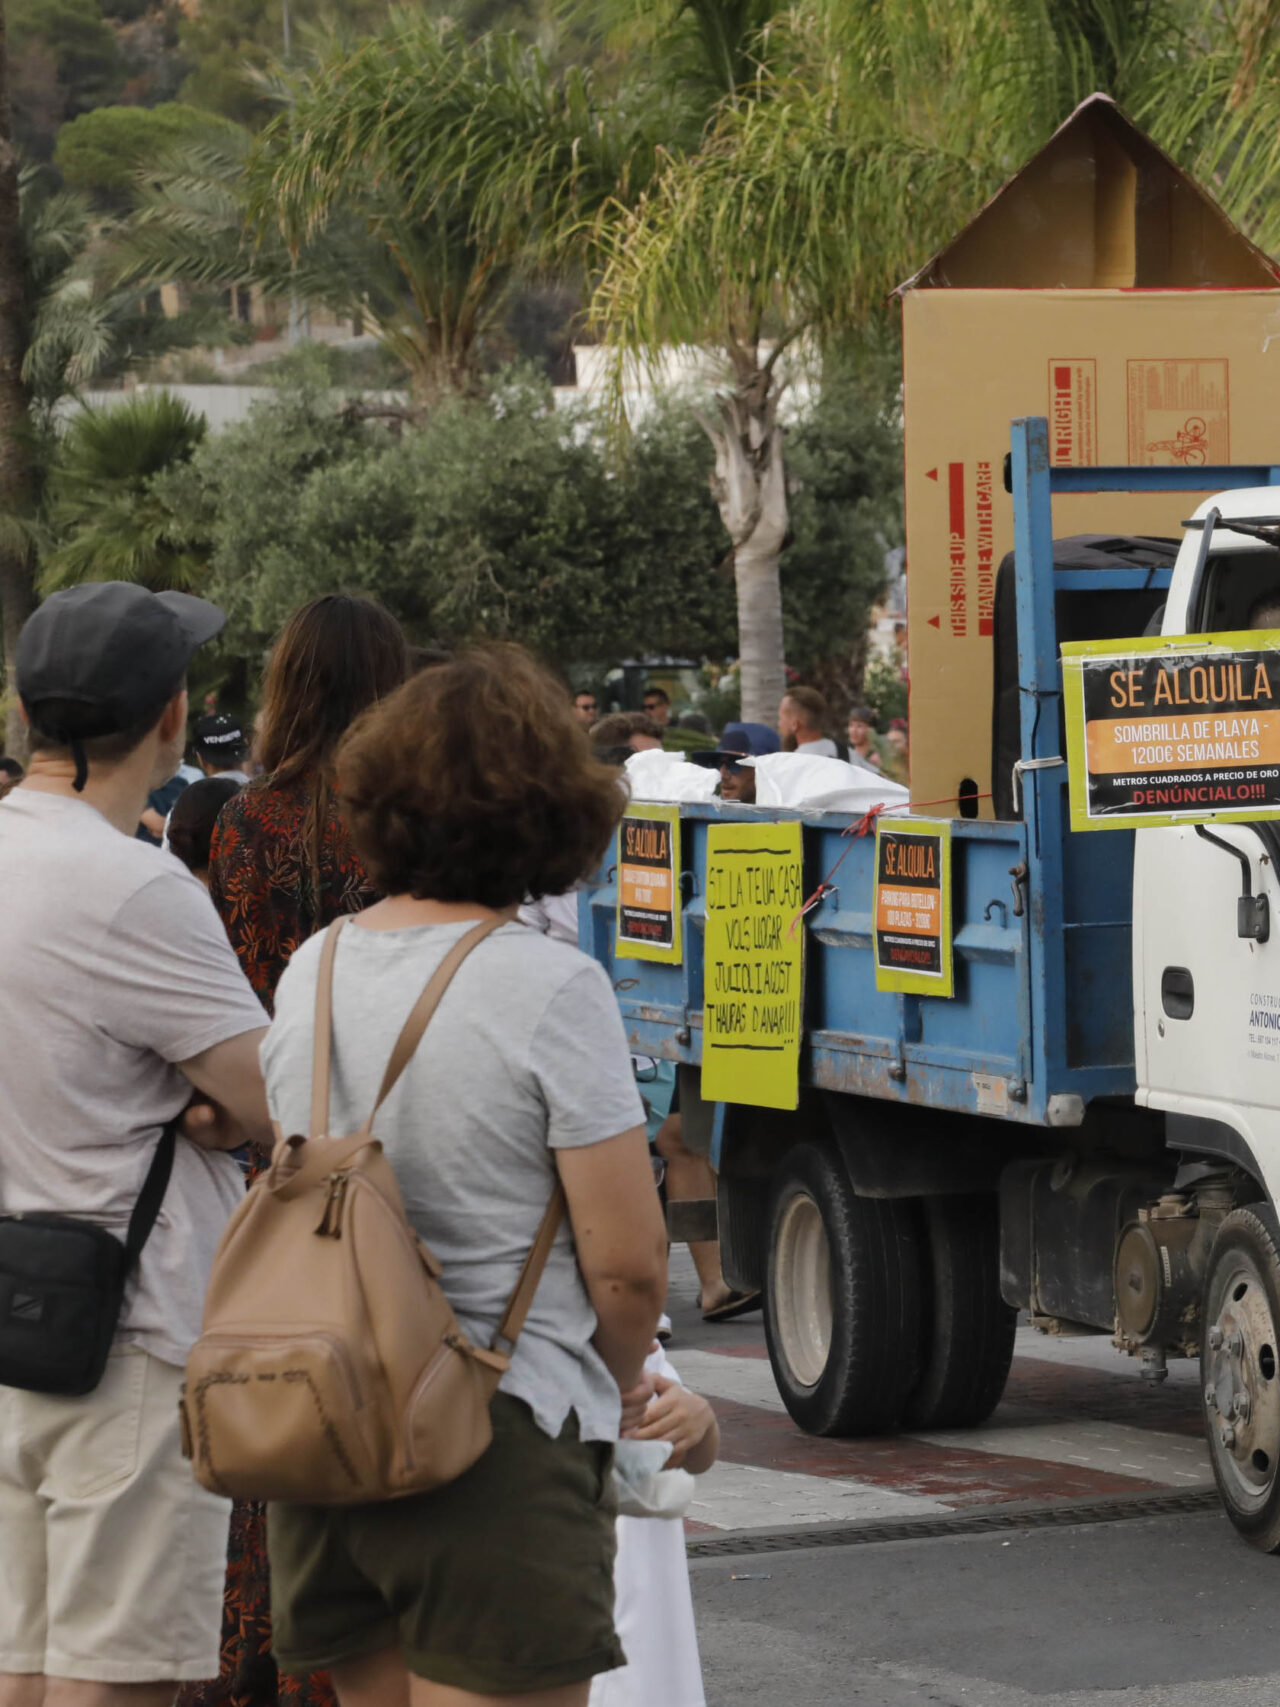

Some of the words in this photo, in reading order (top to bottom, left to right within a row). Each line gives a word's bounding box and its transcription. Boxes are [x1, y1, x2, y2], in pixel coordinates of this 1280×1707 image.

[977, 462, 993, 505] CARE
[950, 532, 966, 554] UP
[977, 511, 993, 551] WITH
[950, 559, 966, 595] SIDE
[977, 556, 993, 620] HANDLE
[950, 600, 967, 636] THIS
[1110, 670, 1144, 708] SE
[1154, 663, 1273, 706] ALQUILA
[1114, 722, 1190, 743] SOMBRILLA
[1193, 721, 1210, 738] DE
[1214, 718, 1260, 737] PLAYA
[1131, 745, 1173, 765] 1200€
[1177, 741, 1260, 762] SEMANALES
[1113, 776, 1148, 787] METROS
[1150, 773, 1203, 785] CUADRADOS
[1204, 773, 1212, 782] A
[1213, 771, 1244, 781] PRECIO
[1247, 770, 1258, 779] DE
[1260, 769, 1279, 778] ORO
[1133, 783, 1266, 805] DENÚNCIALO!!!
[886, 843, 897, 876] SE
[897, 845, 935, 878] ALQUILA
[709, 866, 726, 910] SI
[729, 870, 744, 909] LA
